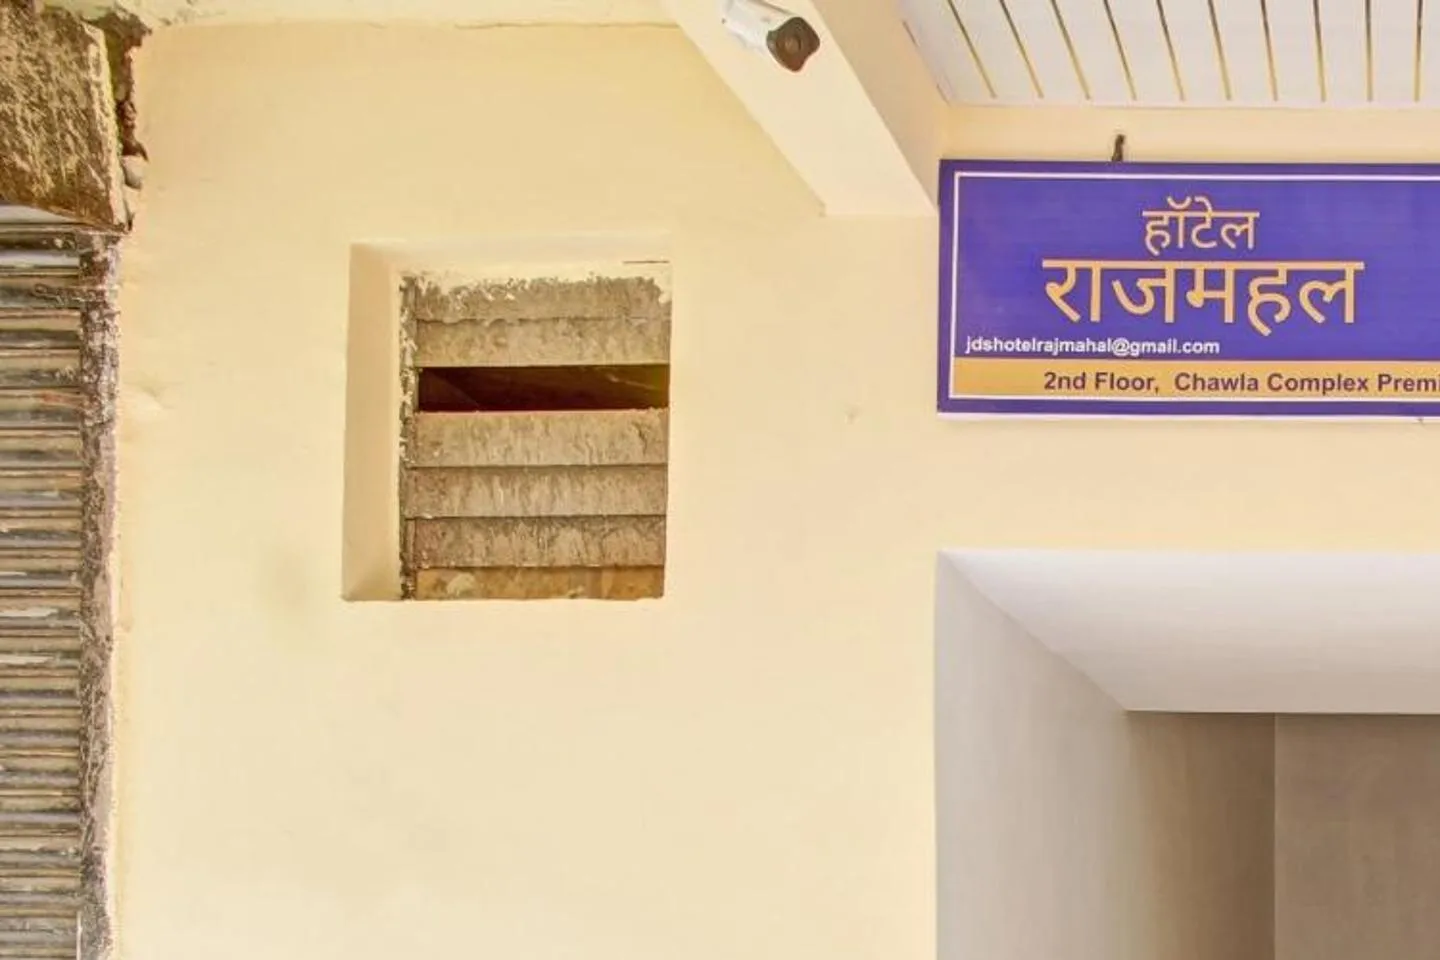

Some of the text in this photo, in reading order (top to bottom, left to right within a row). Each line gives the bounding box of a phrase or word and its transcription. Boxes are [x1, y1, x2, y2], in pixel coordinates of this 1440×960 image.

[1142, 195, 1260, 255] हॉटेल
[1042, 258, 1365, 336] राजमहल
[964, 335, 1220, 356] jdshotelrajmahal@gmail.com
[1043, 371, 1086, 390] 2nd
[1094, 371, 1159, 394] Floor,
[1174, 372, 1258, 391] Chawla
[1267, 373, 1368, 394] Complex
